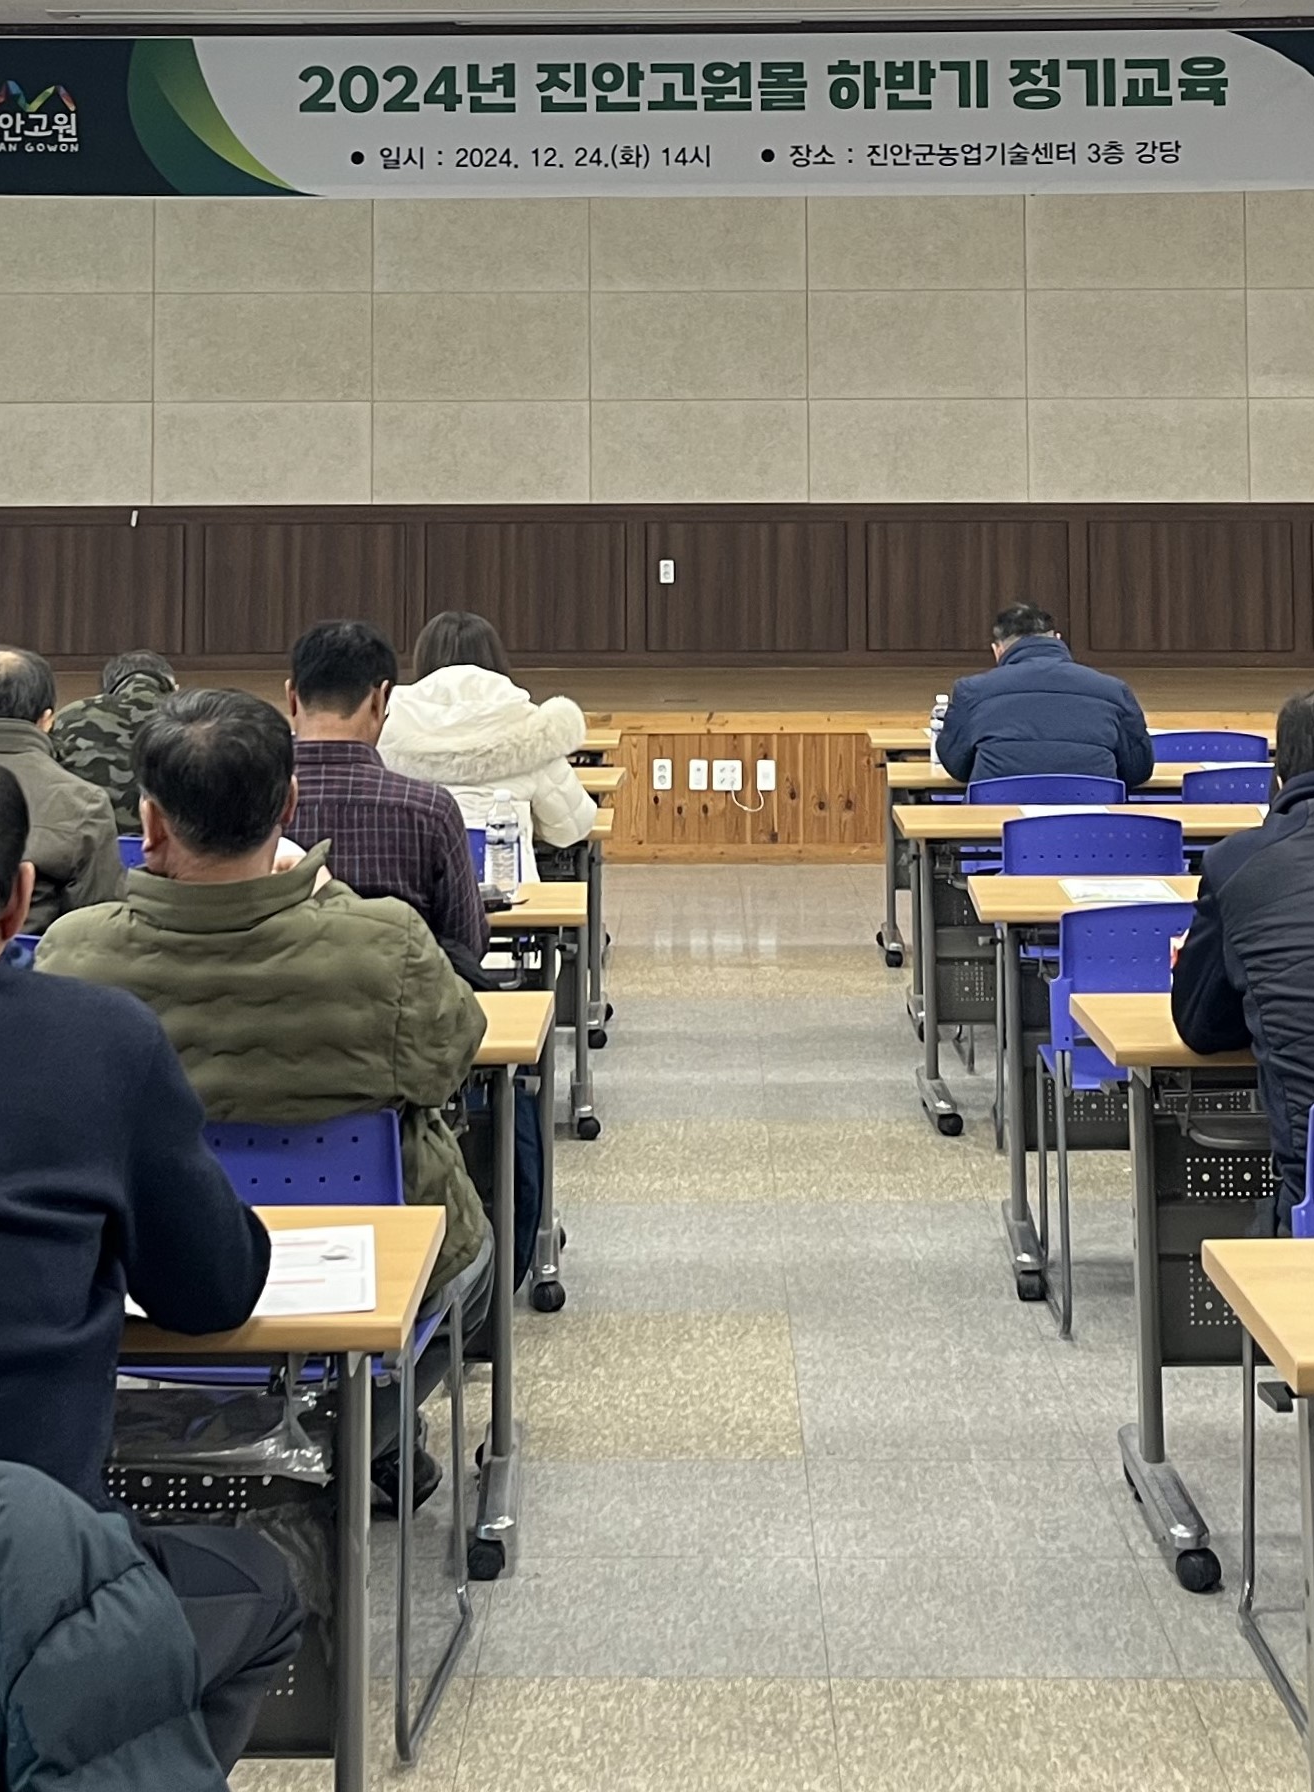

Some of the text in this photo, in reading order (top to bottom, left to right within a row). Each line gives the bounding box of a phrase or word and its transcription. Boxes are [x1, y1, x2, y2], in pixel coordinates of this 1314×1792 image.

[298, 55, 1229, 115] 2024년 진안고원몰 하반기 정기교육
[25, 142, 79, 152] GOWON
[379, 145, 425, 170] 일시
[455, 146, 520, 170] 2024.
[531, 146, 565, 170] 12.
[574, 143, 651, 171] 24.(화)
[661, 143, 712, 169] 14시
[789, 142, 837, 168] 장소
[866, 140, 1077, 168] 진안군농업기술센터
[1087, 139, 1127, 166] 3층
[1135, 138, 1183, 166] 강당
